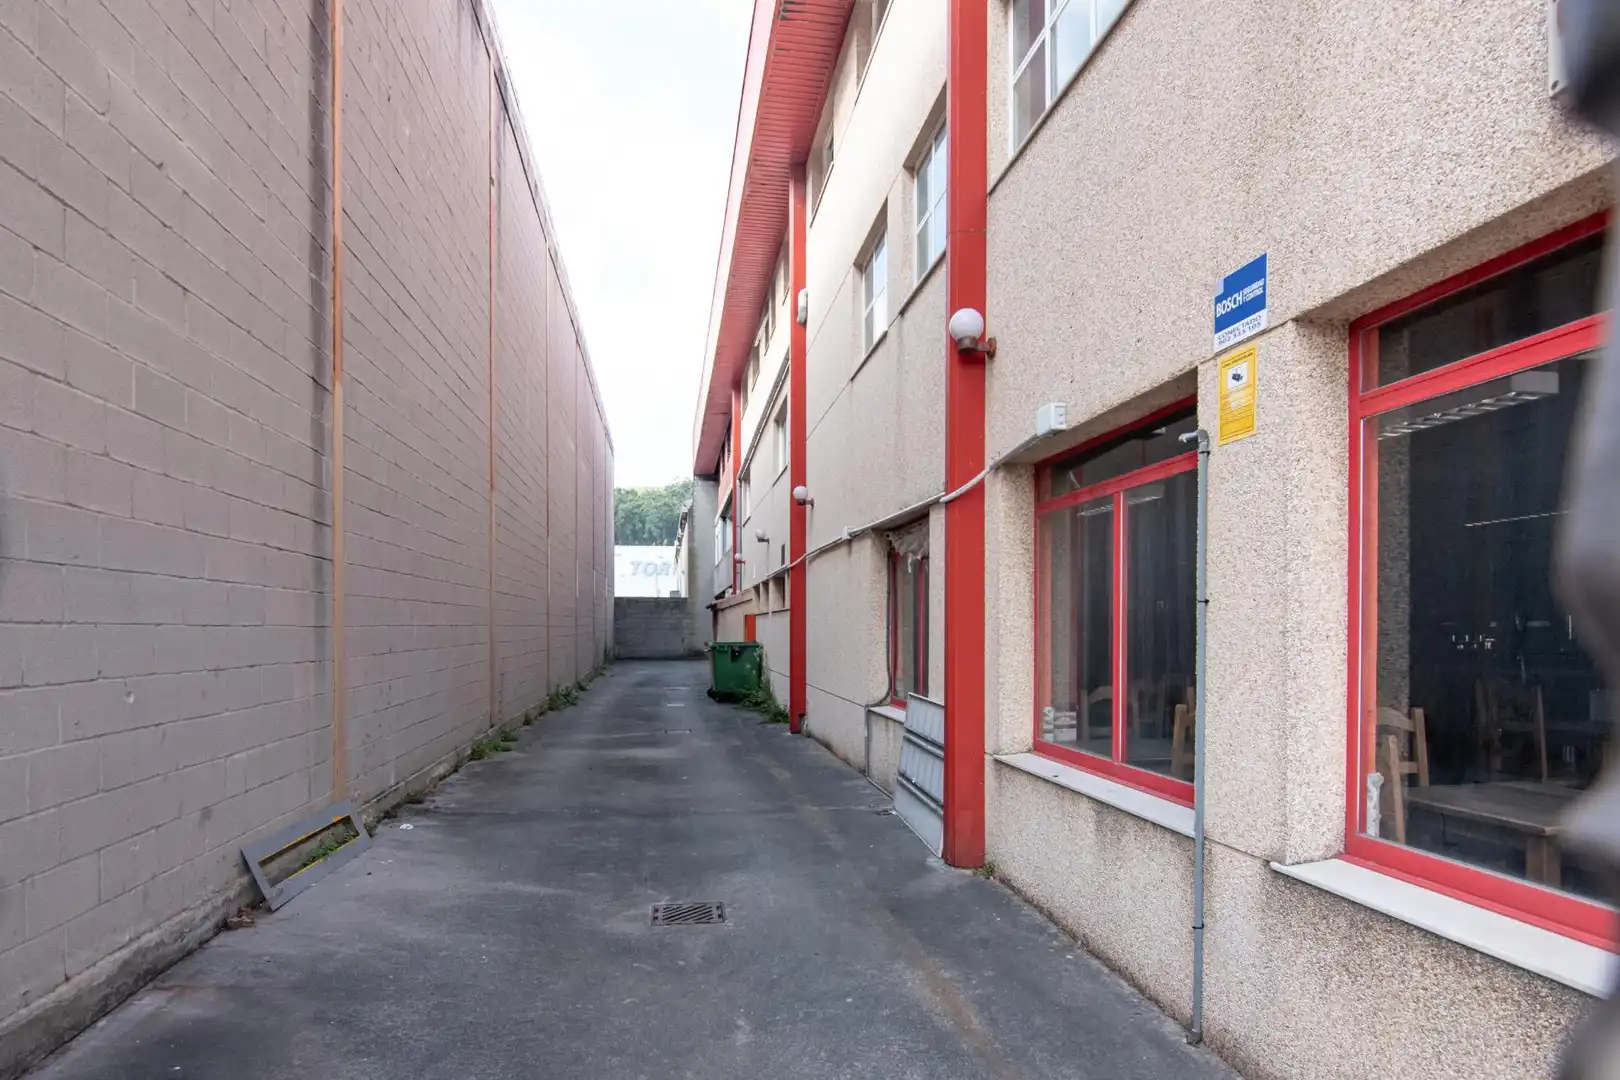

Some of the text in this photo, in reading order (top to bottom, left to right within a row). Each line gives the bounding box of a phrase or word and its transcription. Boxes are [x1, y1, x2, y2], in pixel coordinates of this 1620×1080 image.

[1216, 290, 1242, 318] BOSCH
[1218, 315, 1261, 340] CONECTADO
[630, 561, 675, 577] TOR
